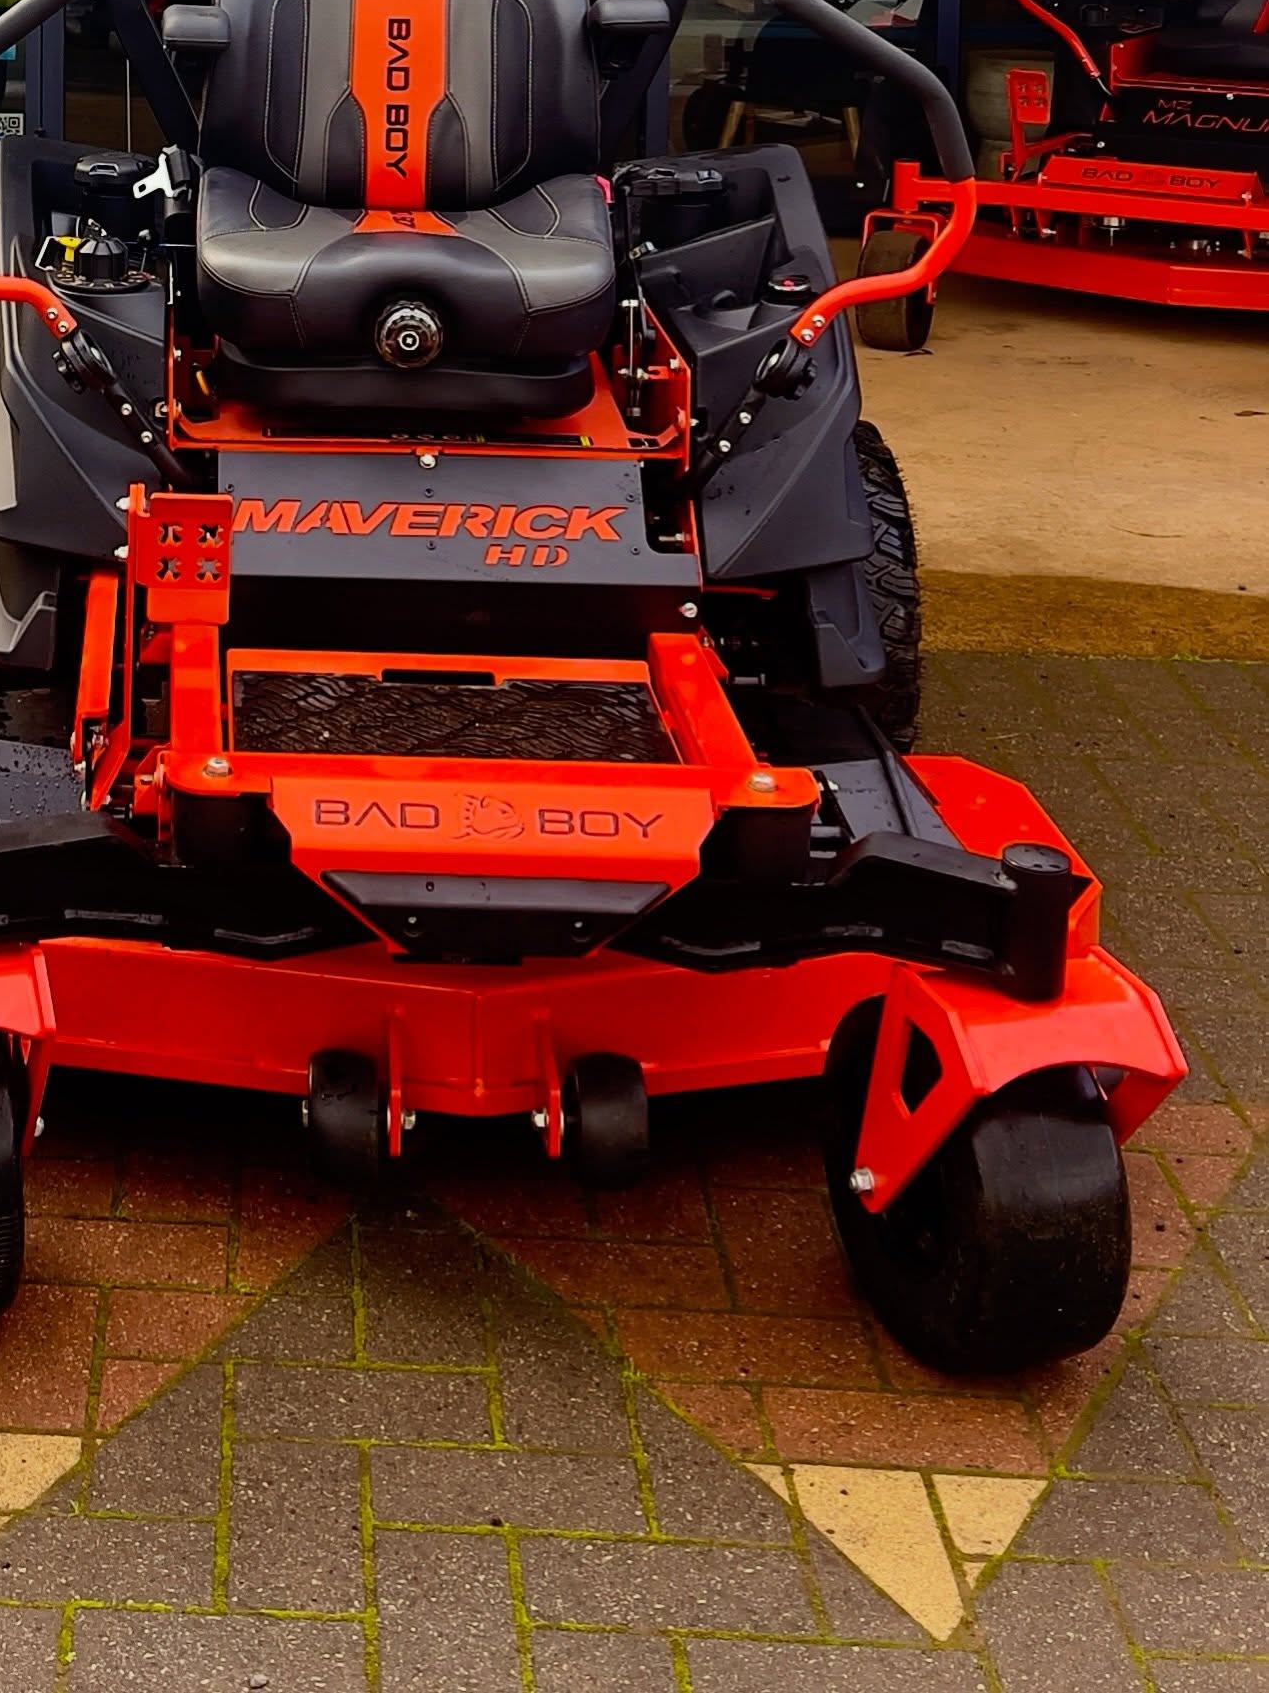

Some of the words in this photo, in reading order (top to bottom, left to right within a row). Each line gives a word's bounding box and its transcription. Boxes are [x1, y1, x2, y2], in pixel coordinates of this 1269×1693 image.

[387, 18, 411, 92] BAD
[386, 104, 409, 179] BOY
[1081, 167, 1133, 182] BAD
[1169, 175, 1221, 188] BOY
[232, 498, 627, 540] MAVERICK
[484, 544, 568, 567] HD
[314, 800, 439, 830] BAD
[538, 808, 663, 838] BOY
